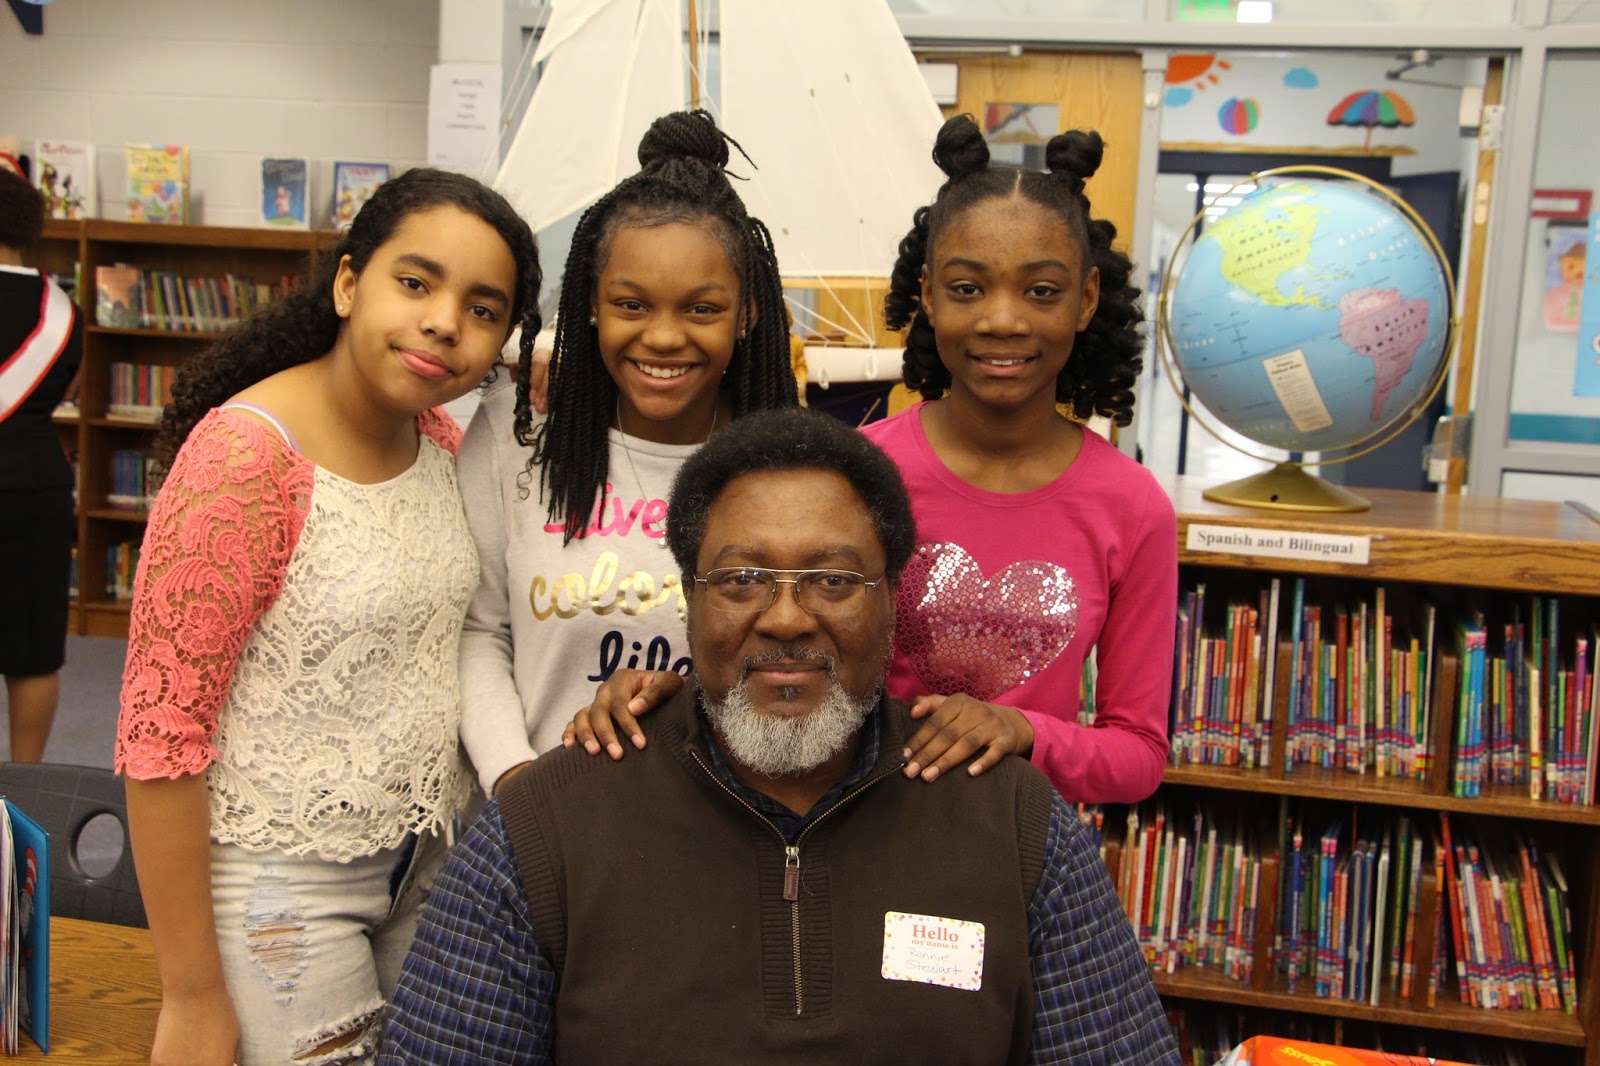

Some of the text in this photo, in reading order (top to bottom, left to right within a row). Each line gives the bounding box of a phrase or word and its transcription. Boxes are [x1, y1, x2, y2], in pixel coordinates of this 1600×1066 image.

[1197, 530, 1354, 555] Spanish and Bilingual
[913, 924, 958, 942] Hello
[911, 939, 925, 947] my
[926, 941, 950, 949] name
[907, 946, 950, 962] Ronnie
[905, 959, 962, 975] Stewart
